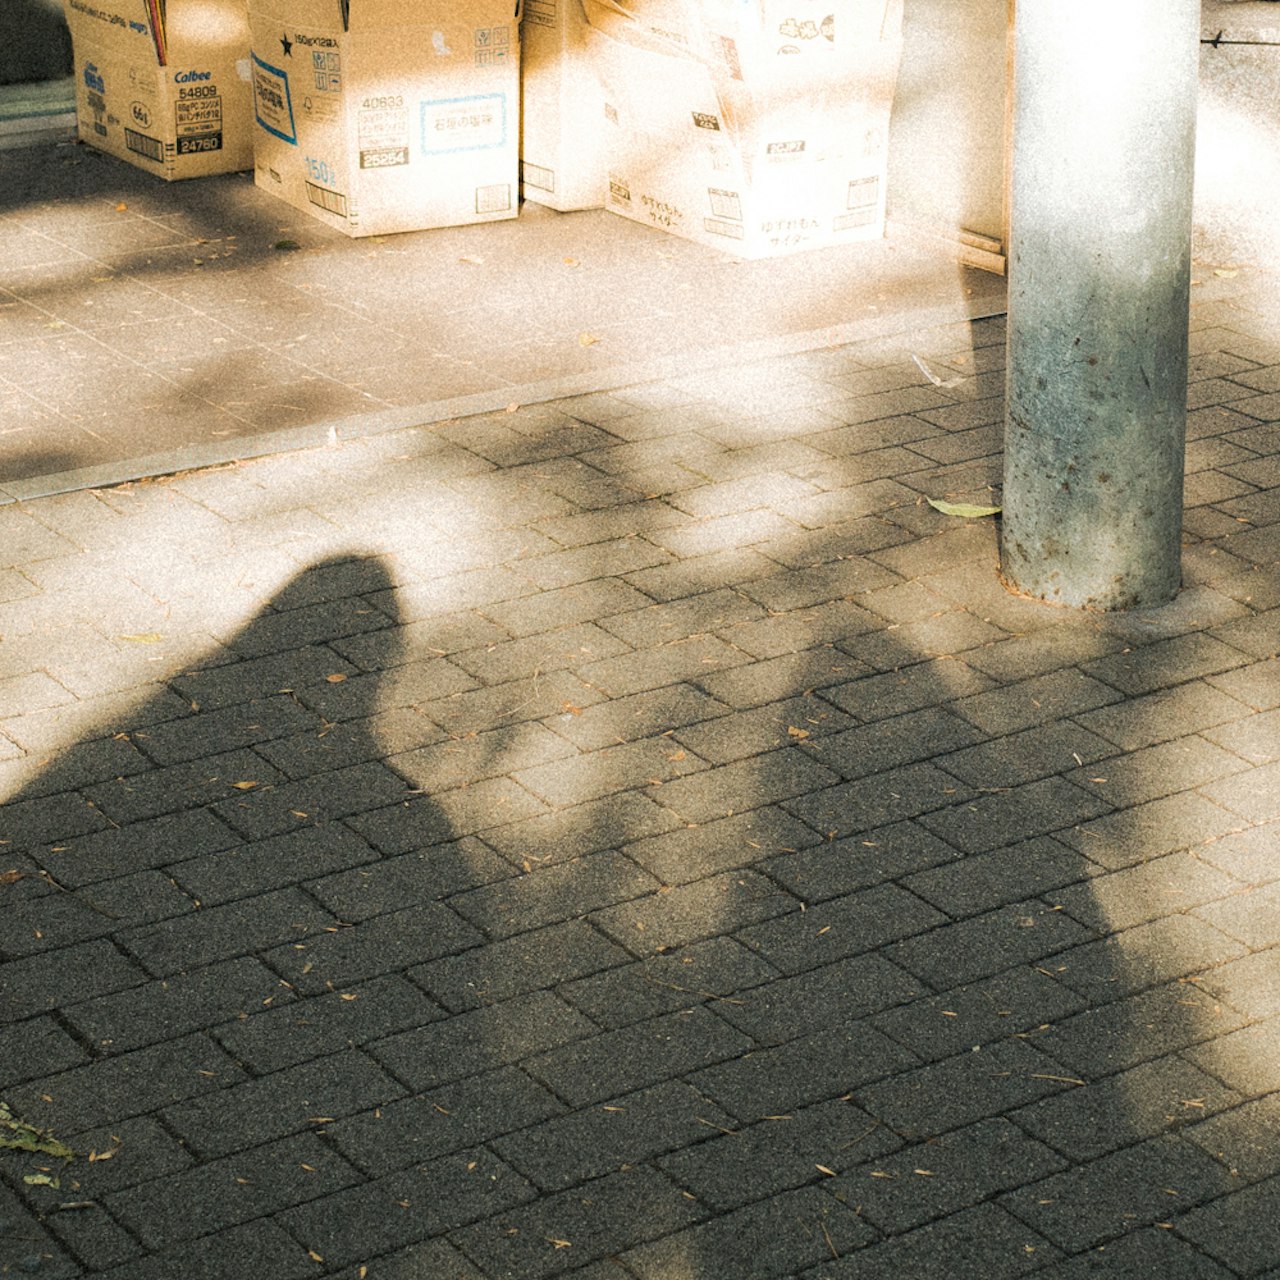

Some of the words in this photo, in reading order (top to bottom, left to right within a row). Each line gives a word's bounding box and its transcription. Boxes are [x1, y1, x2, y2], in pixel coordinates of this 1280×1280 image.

[174, 70, 212, 85] Calbee
[178, 86, 218, 100] 54809
[362, 95, 405, 109] 40633
